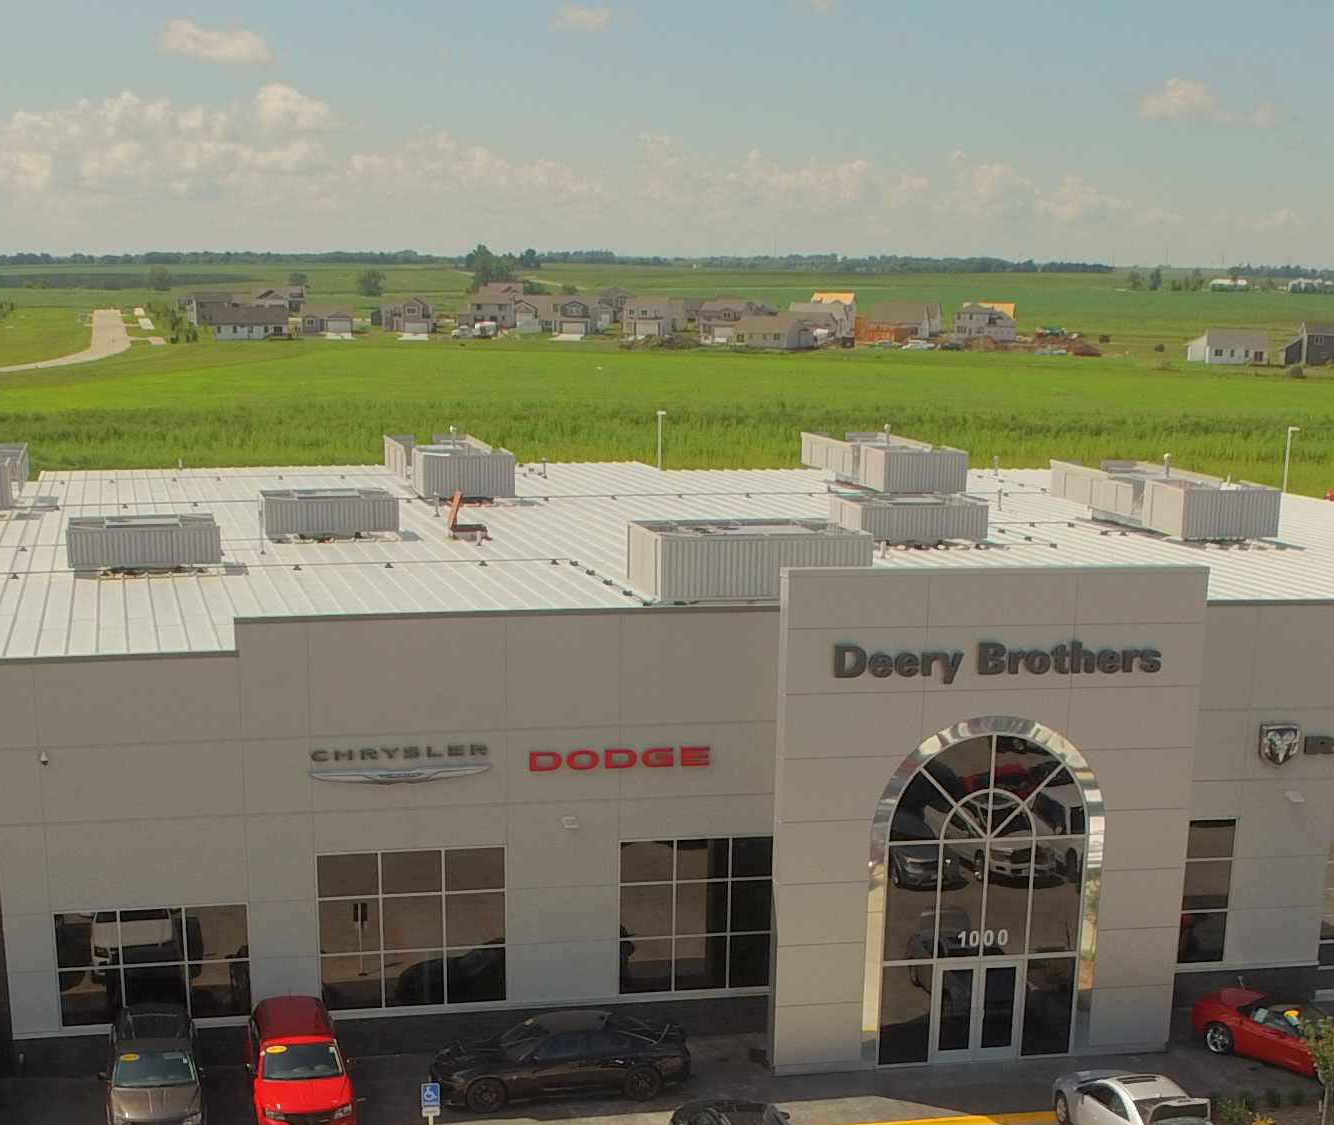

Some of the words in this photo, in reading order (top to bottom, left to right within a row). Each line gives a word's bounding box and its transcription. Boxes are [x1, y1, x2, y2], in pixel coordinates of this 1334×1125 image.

[832, 641, 964, 685] Deery
[976, 639, 1163, 675] Brothers
[311, 743, 488, 762] CHRYSLER
[529, 745, 710, 772] DODGE
[957, 929, 1009, 948] 1000
